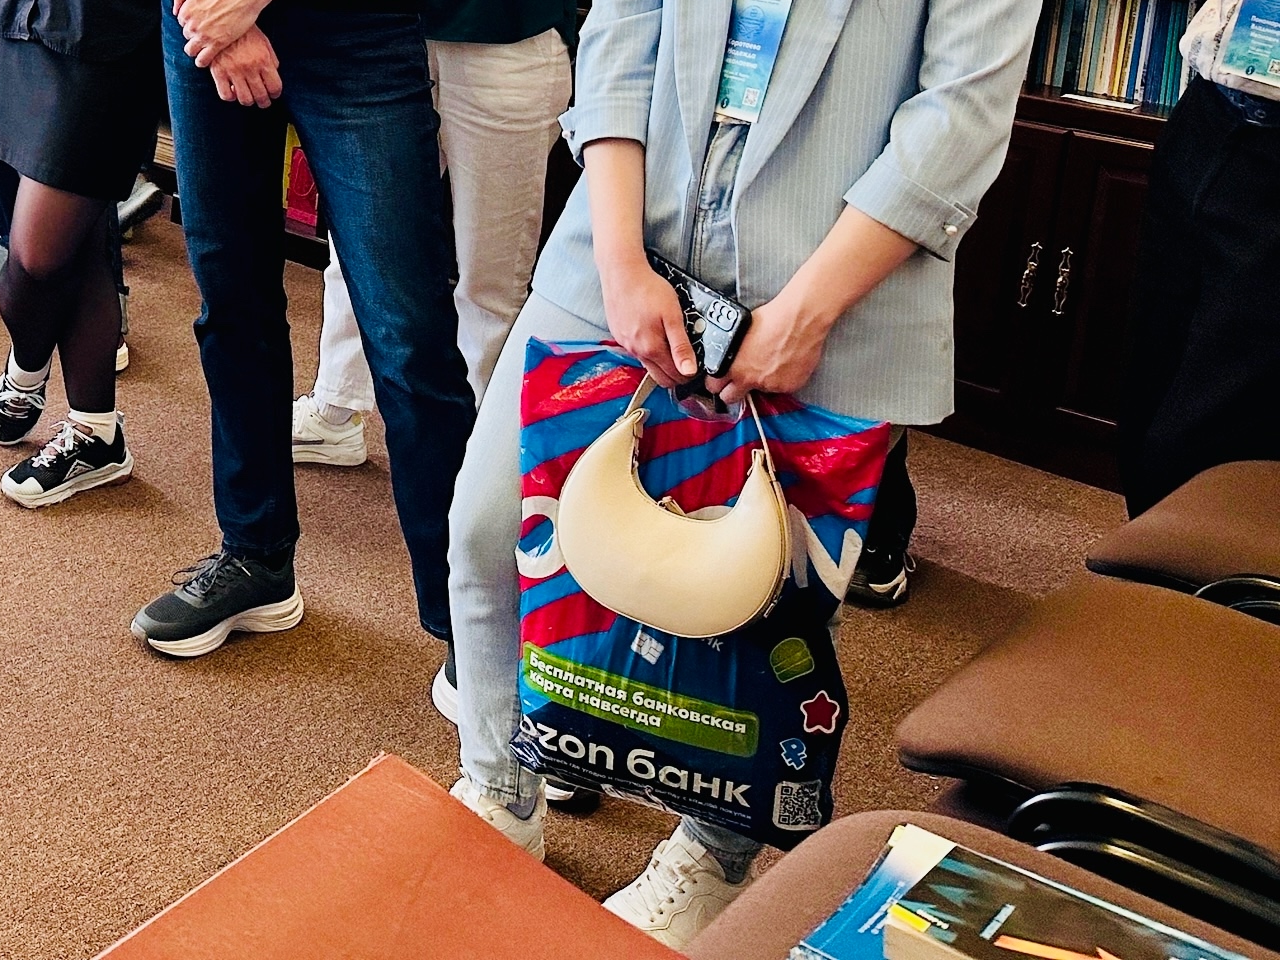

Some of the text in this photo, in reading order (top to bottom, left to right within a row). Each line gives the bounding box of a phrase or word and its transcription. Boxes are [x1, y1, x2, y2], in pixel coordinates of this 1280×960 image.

[528, 668, 662, 728] карта навсегда
[529, 652, 747, 734] Бесплатная банковская
[519, 715, 752, 808] ozon банк
